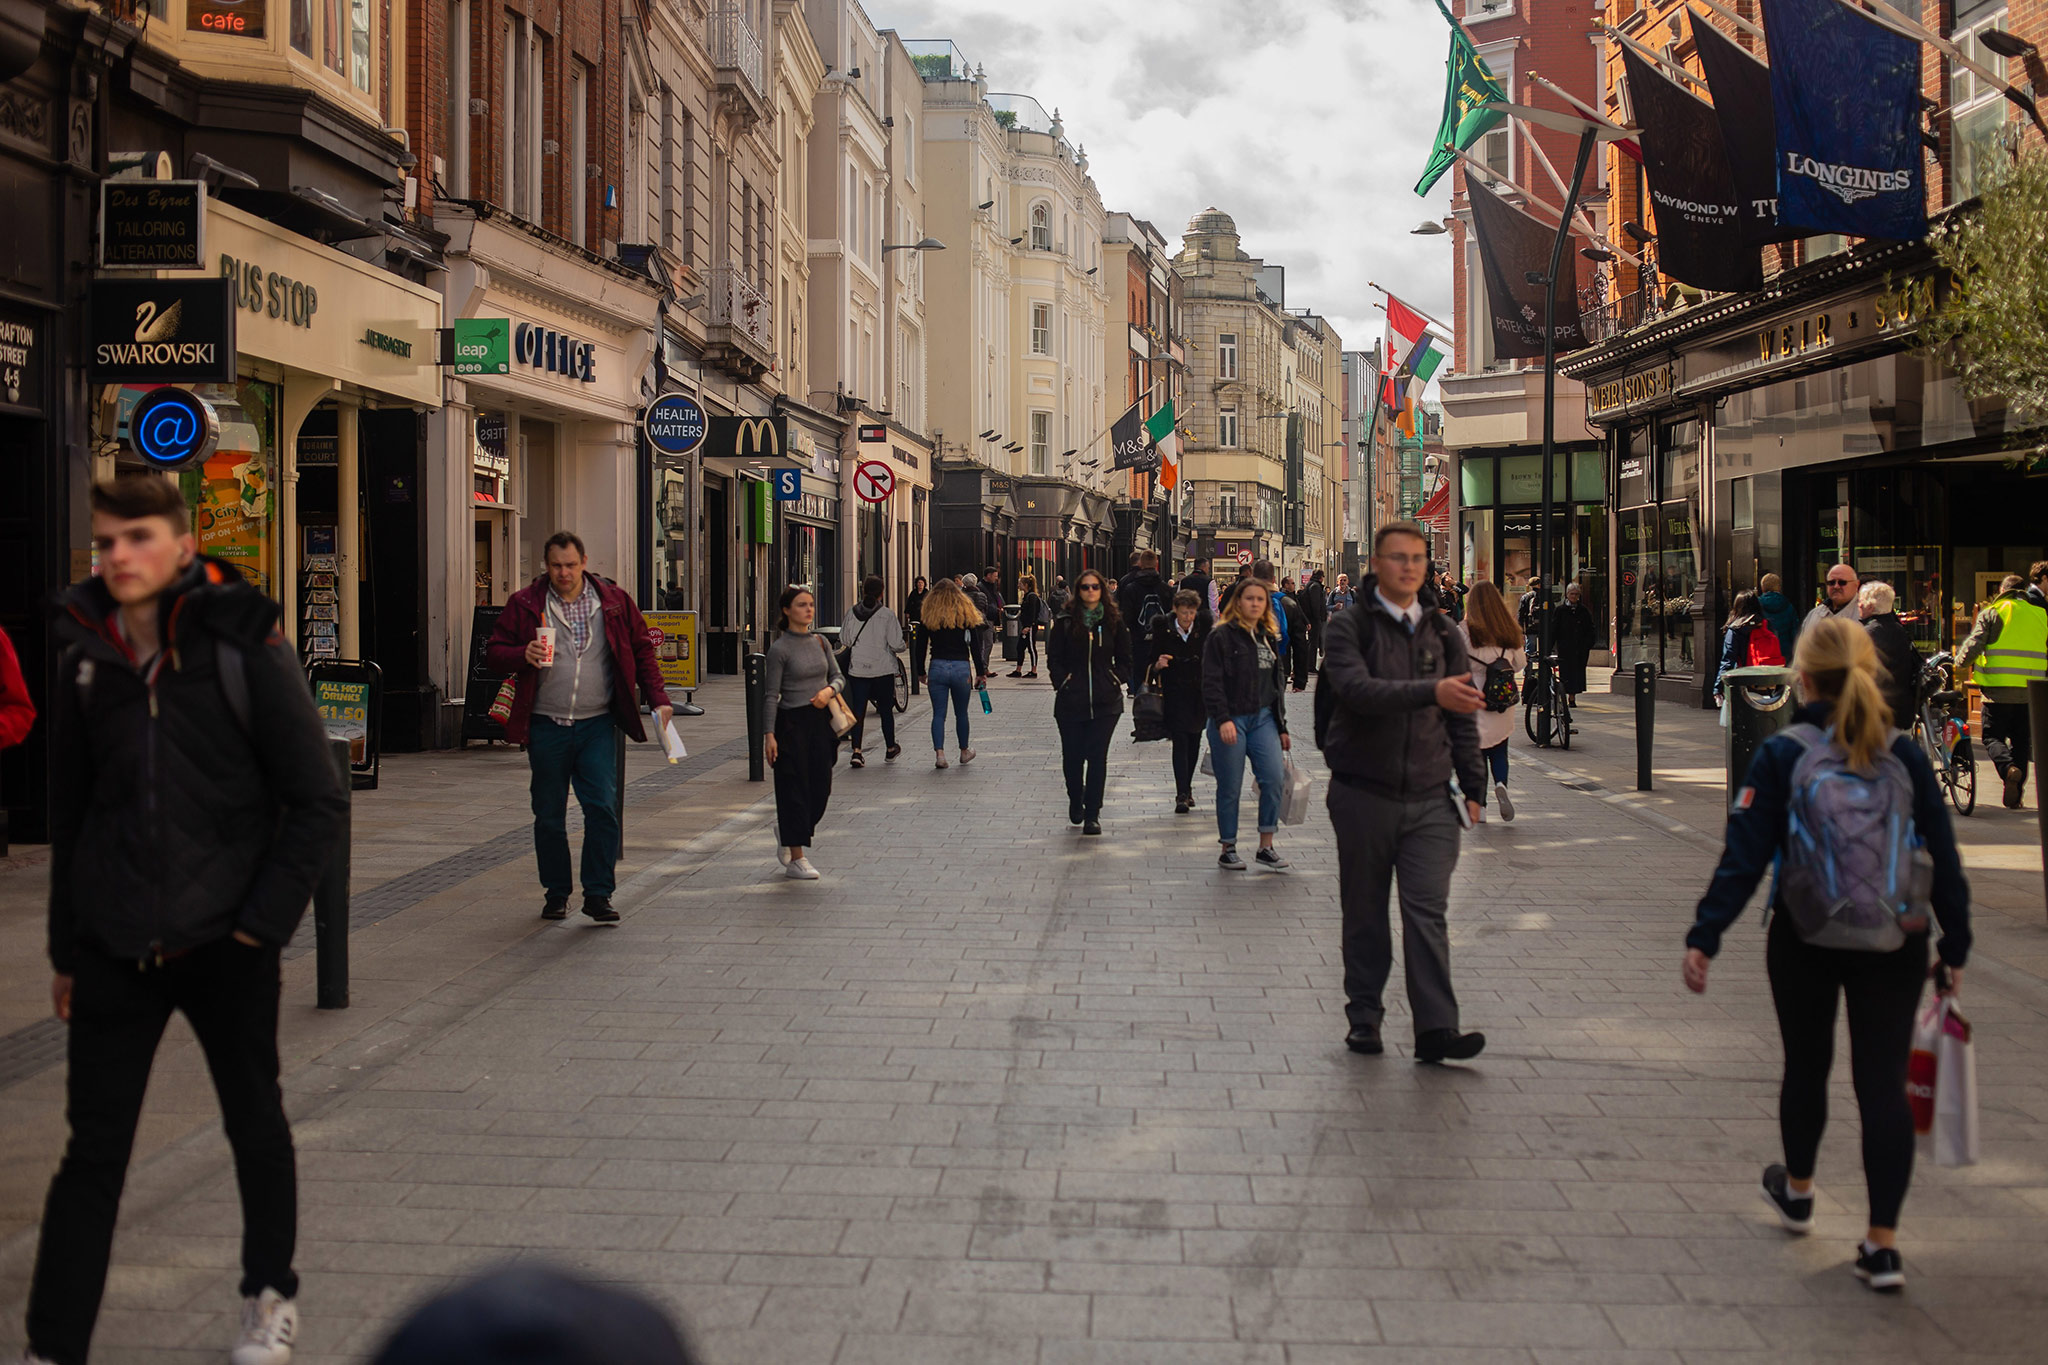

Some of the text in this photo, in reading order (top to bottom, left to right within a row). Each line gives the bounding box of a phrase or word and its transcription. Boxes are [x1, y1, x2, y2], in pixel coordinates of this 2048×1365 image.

[201, 12, 245, 31] cafe
[1787, 152, 1912, 191] LONGINES
[111, 189, 140, 207] Des
[1654, 190, 1720, 215] RAYMOND
[1683, 213, 1724, 225] GENEVE
[116, 220, 185, 237] TAILORING
[105, 243, 196, 260] ALTERATIONS
[268, 271, 318, 329] STOP
[1496, 316, 1525, 334] PATEK
[1759, 314, 1829, 361] WEIR
[96, 343, 215, 365] SWAROVSKI
[457, 342, 488, 359] leap
[515, 322, 596, 382] OFFICE
[1592, 383, 1620, 412] WEIR
[1625, 371, 1656, 404] SONS
[655, 408, 698, 421] HEALTH
[650, 424, 703, 438] MATTERS
[1113, 436, 1145, 458] M&S
[215, 506, 239, 519] City
[1027, 500, 1036, 509] 16
[320, 683, 365, 694] ALL HOT
[322, 691, 361, 702] DRINKS
